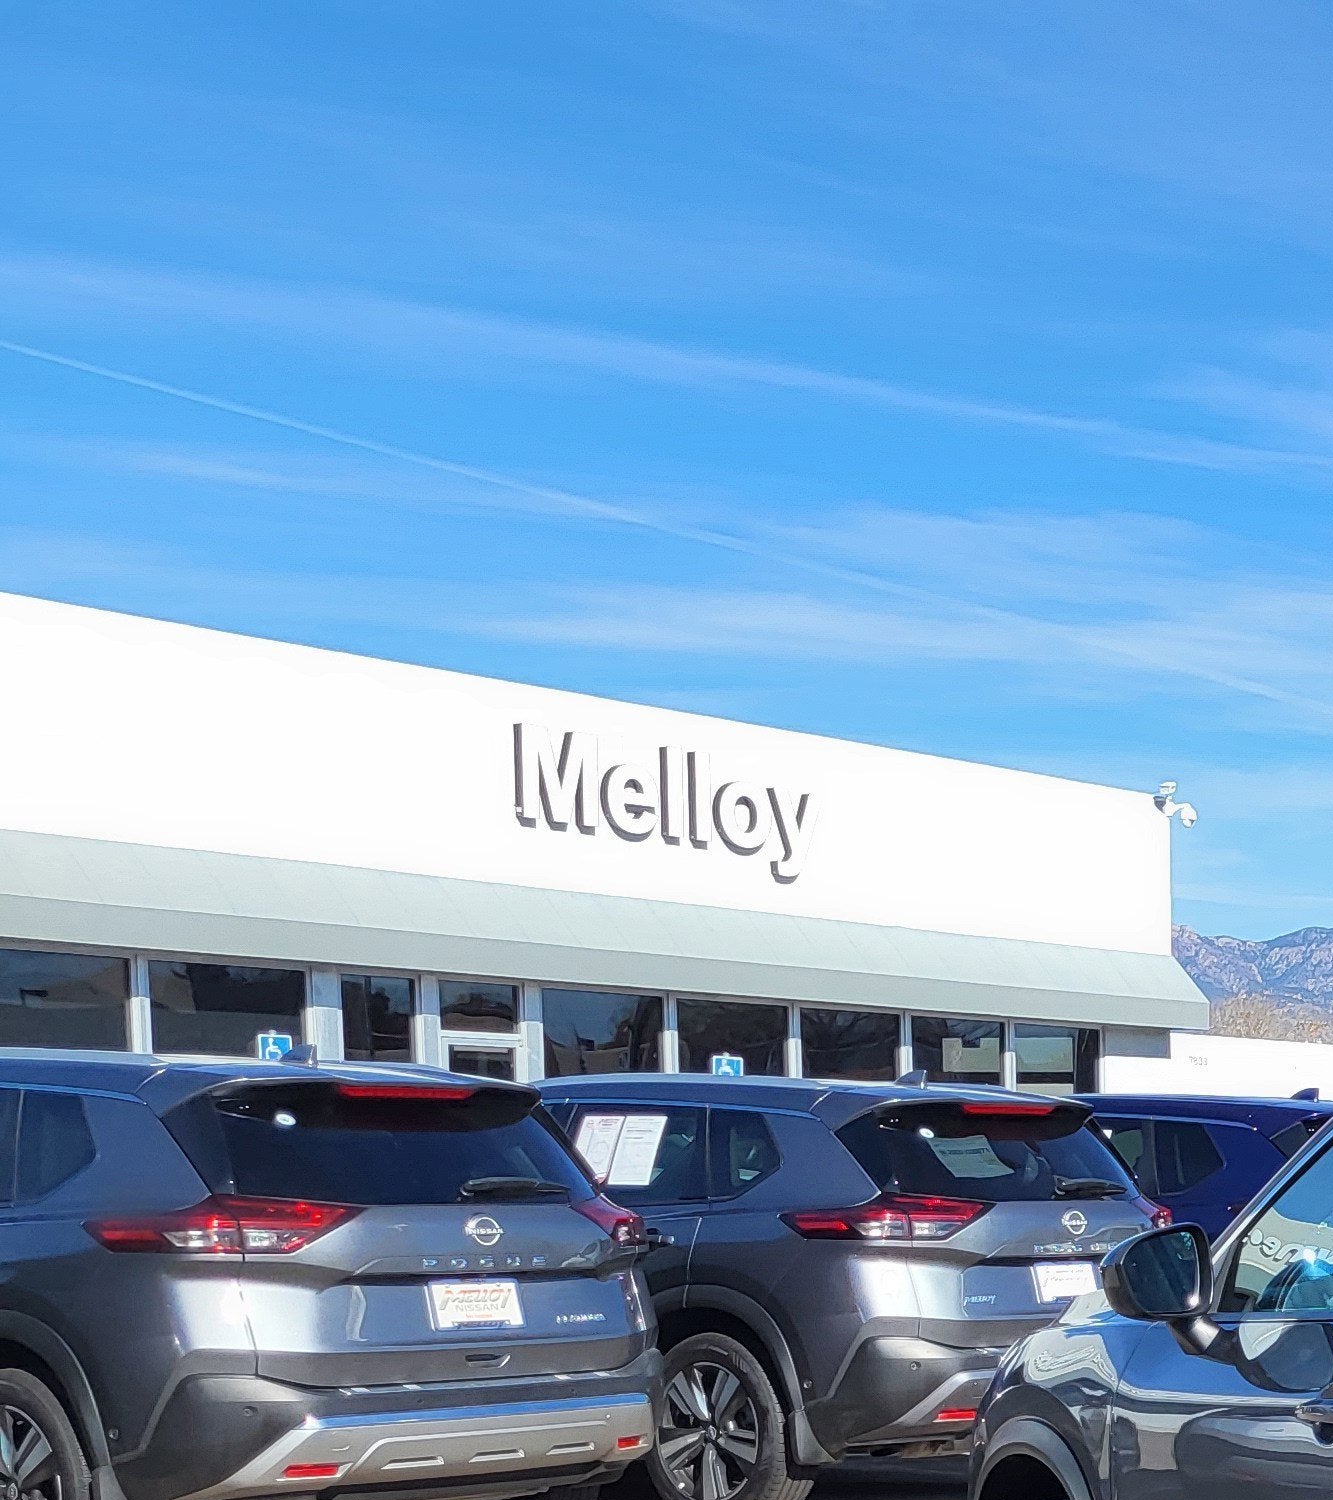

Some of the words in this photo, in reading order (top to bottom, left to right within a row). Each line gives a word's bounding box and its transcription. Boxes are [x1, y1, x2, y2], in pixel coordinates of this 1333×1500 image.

[512, 722, 822, 885] Melloy
[467, 1227, 504, 1235] NISSAN
[439, 1288, 512, 1311] MELLOY
[455, 1303, 500, 1312] NISSAN
